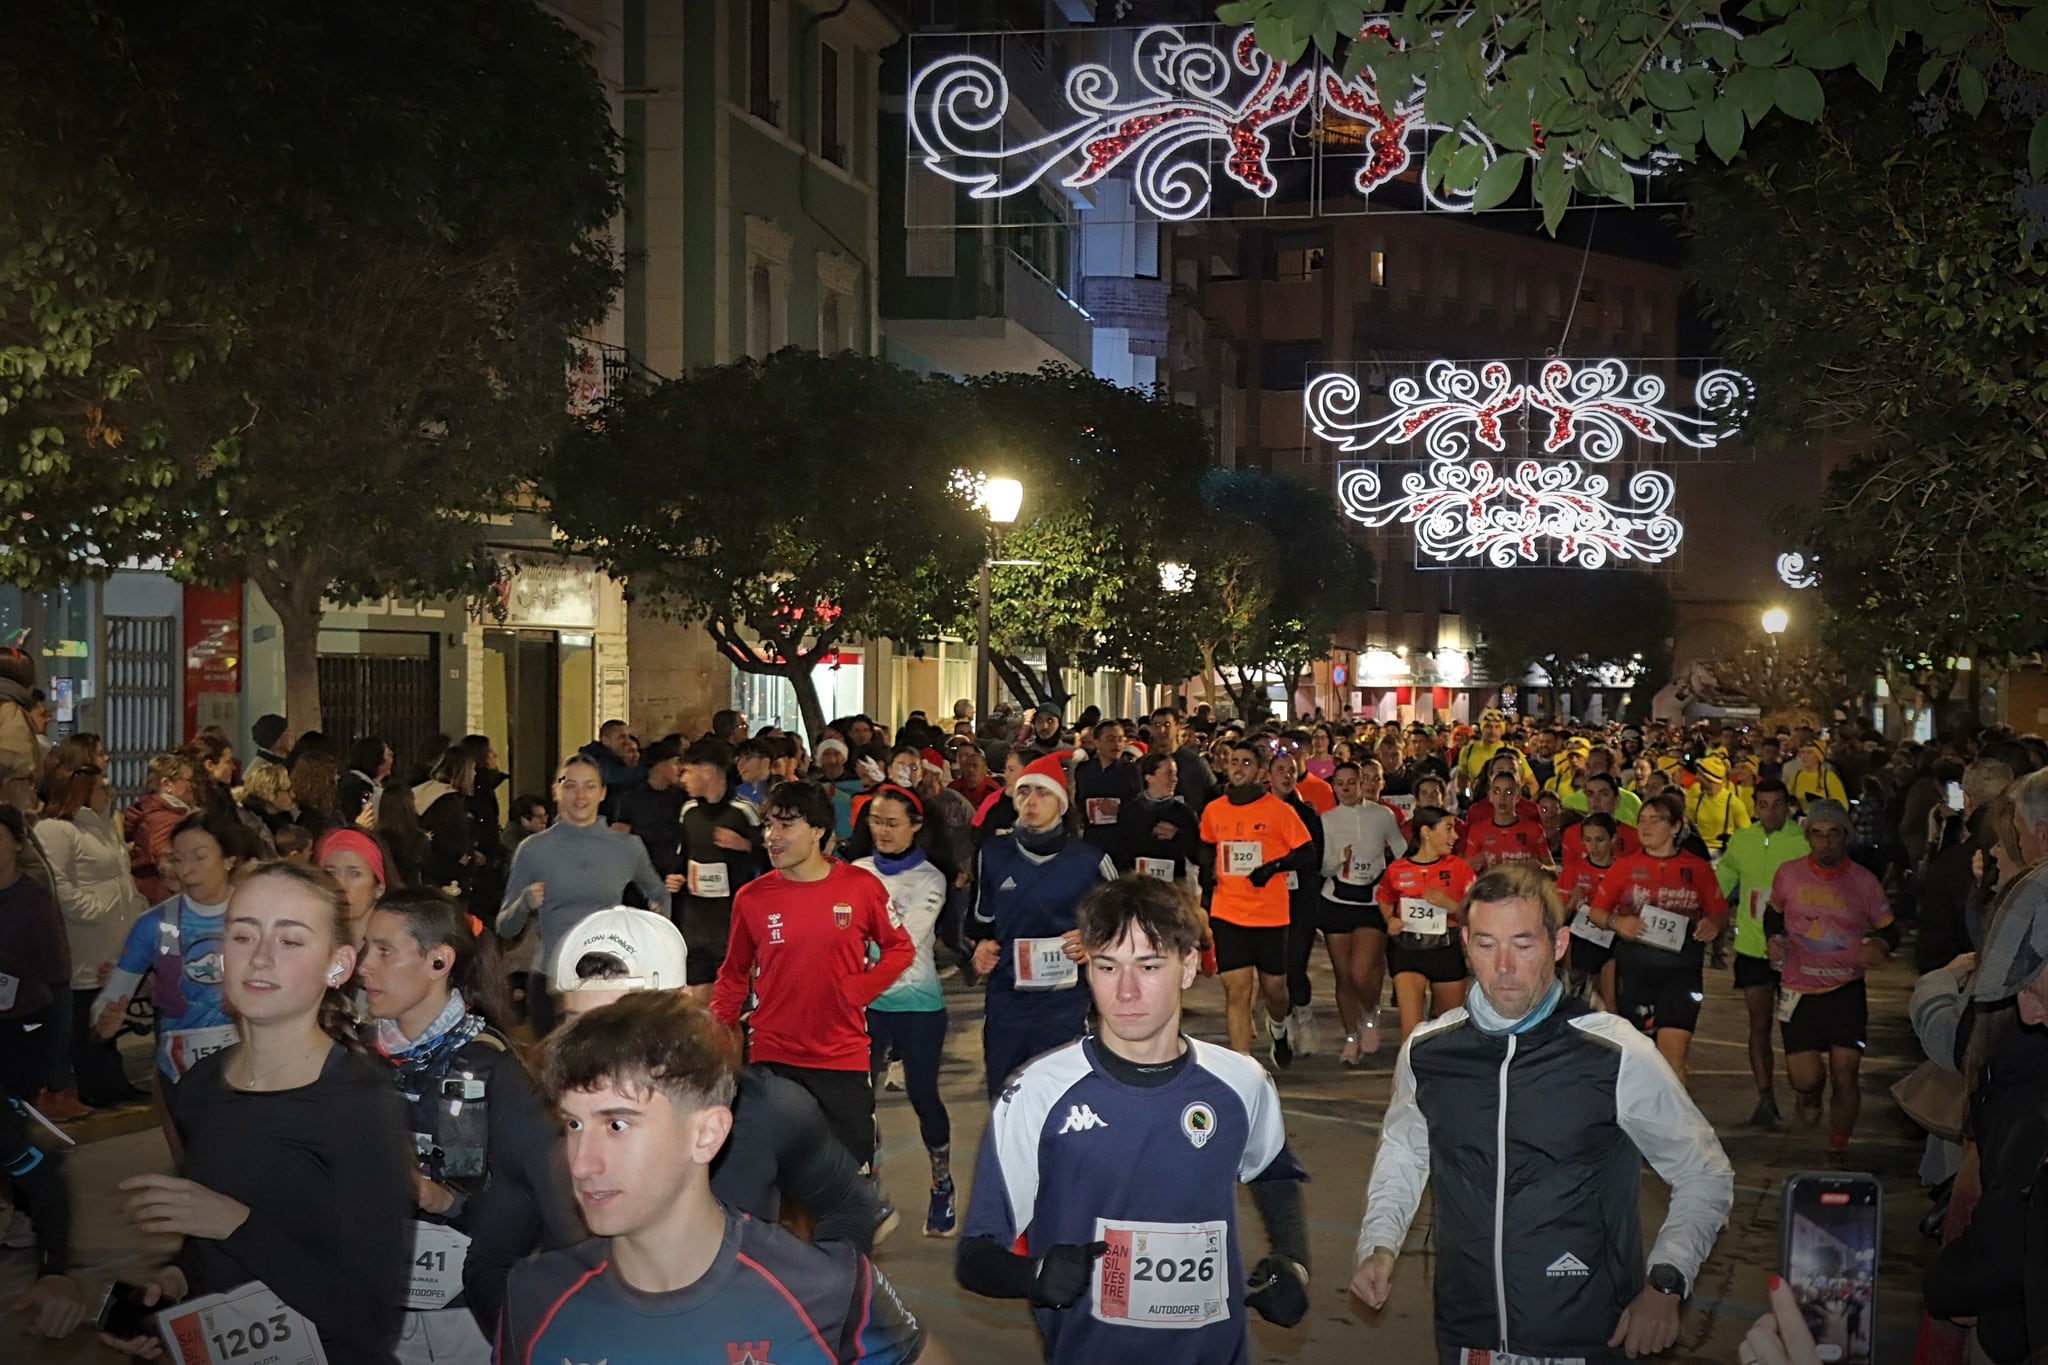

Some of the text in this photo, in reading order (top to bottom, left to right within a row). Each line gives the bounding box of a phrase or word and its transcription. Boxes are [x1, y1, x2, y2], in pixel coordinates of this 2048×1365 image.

[1233, 853, 1253, 861] 320
[1355, 863, 1371, 871] 297
[1409, 906, 1434, 919] 234
[1651, 916, 1677, 933] 192
[583, 933, 637, 955] FLOW MONKEY
[1043, 951, 1061, 963] 111
[1104, 1244, 1129, 1258] SAN
[1103, 1257, 1121, 1271] SIL
[1133, 1256, 1214, 1283] 2026
[1104, 1270, 1126, 1285] VES
[1104, 1283, 1125, 1298] TRE
[1148, 1304, 1200, 1315] AUTODOPER
[212, 1313, 292, 1360] 1203
